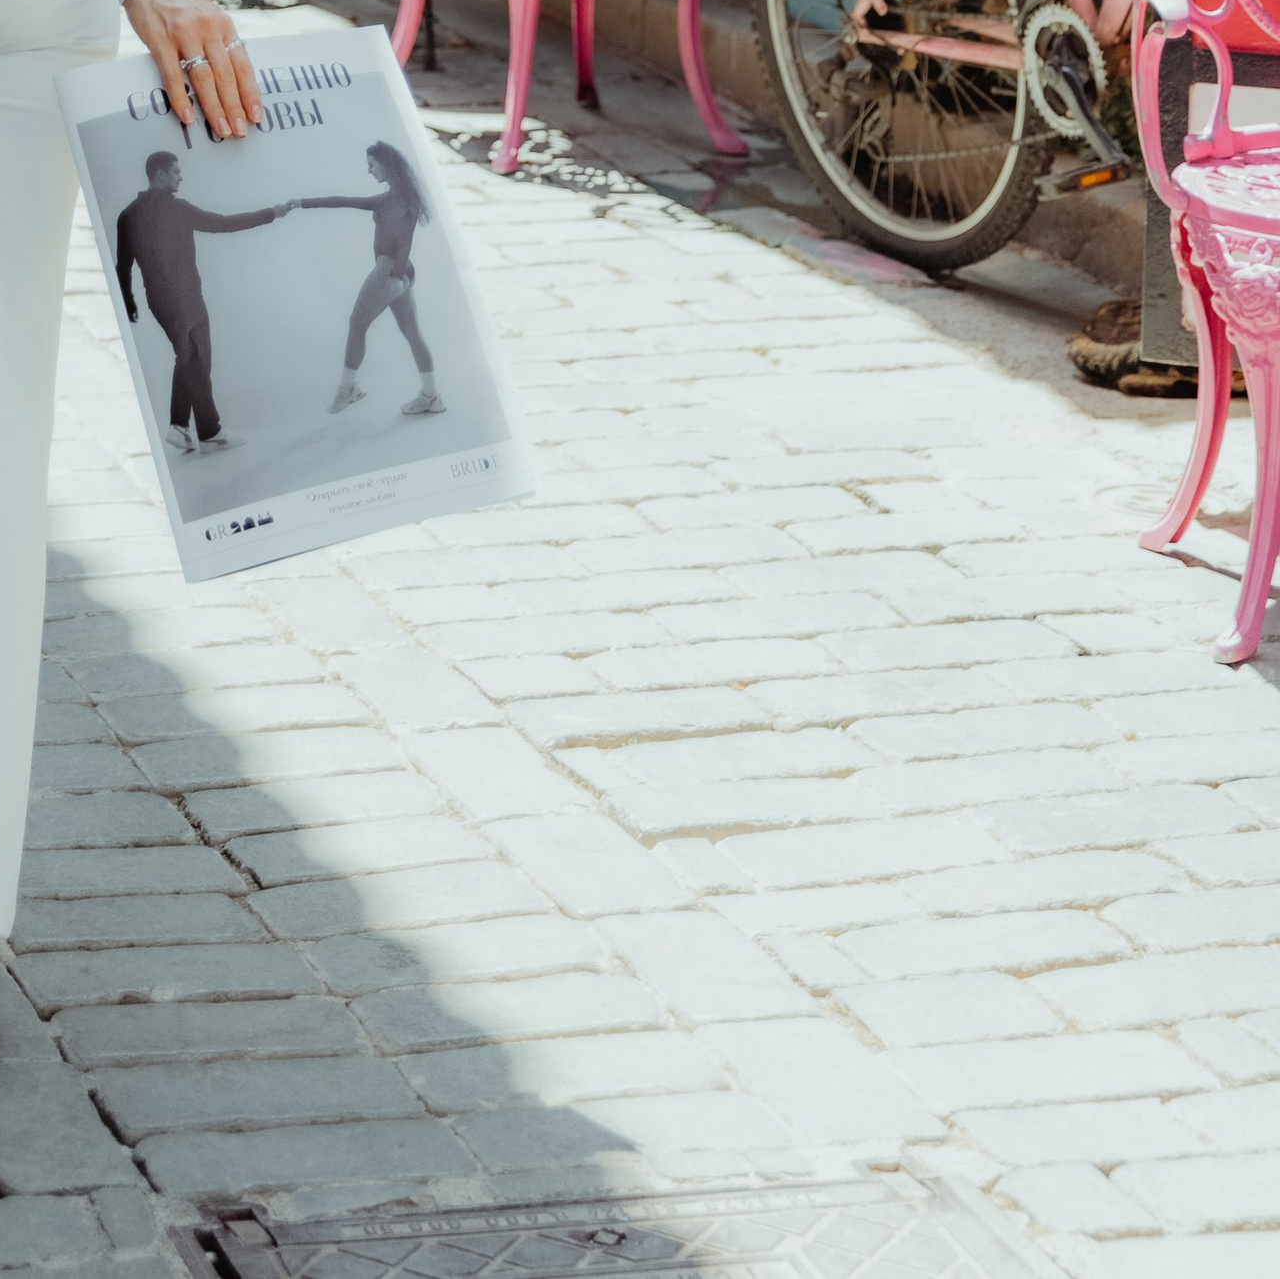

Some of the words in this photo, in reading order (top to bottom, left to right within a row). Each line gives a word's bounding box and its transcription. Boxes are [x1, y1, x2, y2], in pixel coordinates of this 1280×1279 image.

[126, 61, 352, 121] СОЕННО
[449, 453, 502, 478] BRIDE
[306, 486, 352, 503] Открыть
